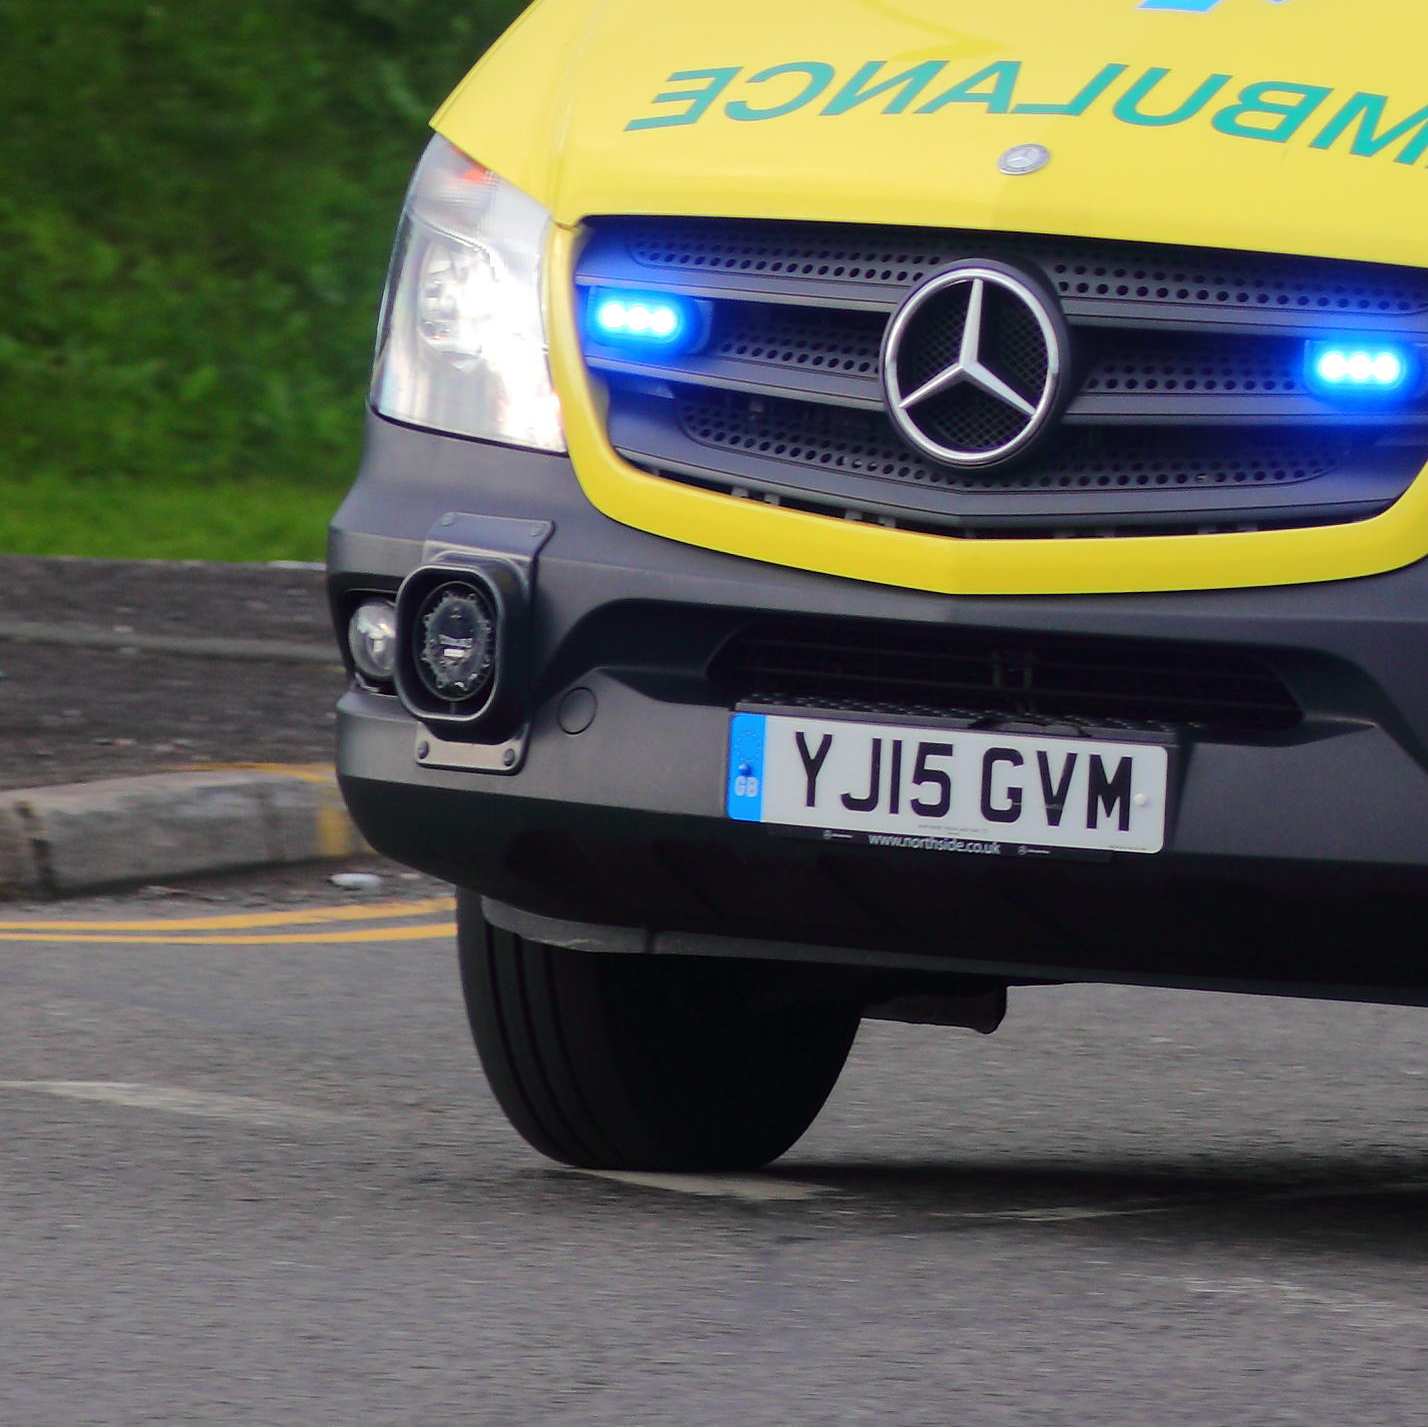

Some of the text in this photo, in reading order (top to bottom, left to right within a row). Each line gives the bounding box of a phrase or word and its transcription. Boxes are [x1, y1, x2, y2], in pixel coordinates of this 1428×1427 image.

[795, 731, 1133, 832] YJ15 GVM
[868, 834, 1001, 855] www.northside.co.uk
